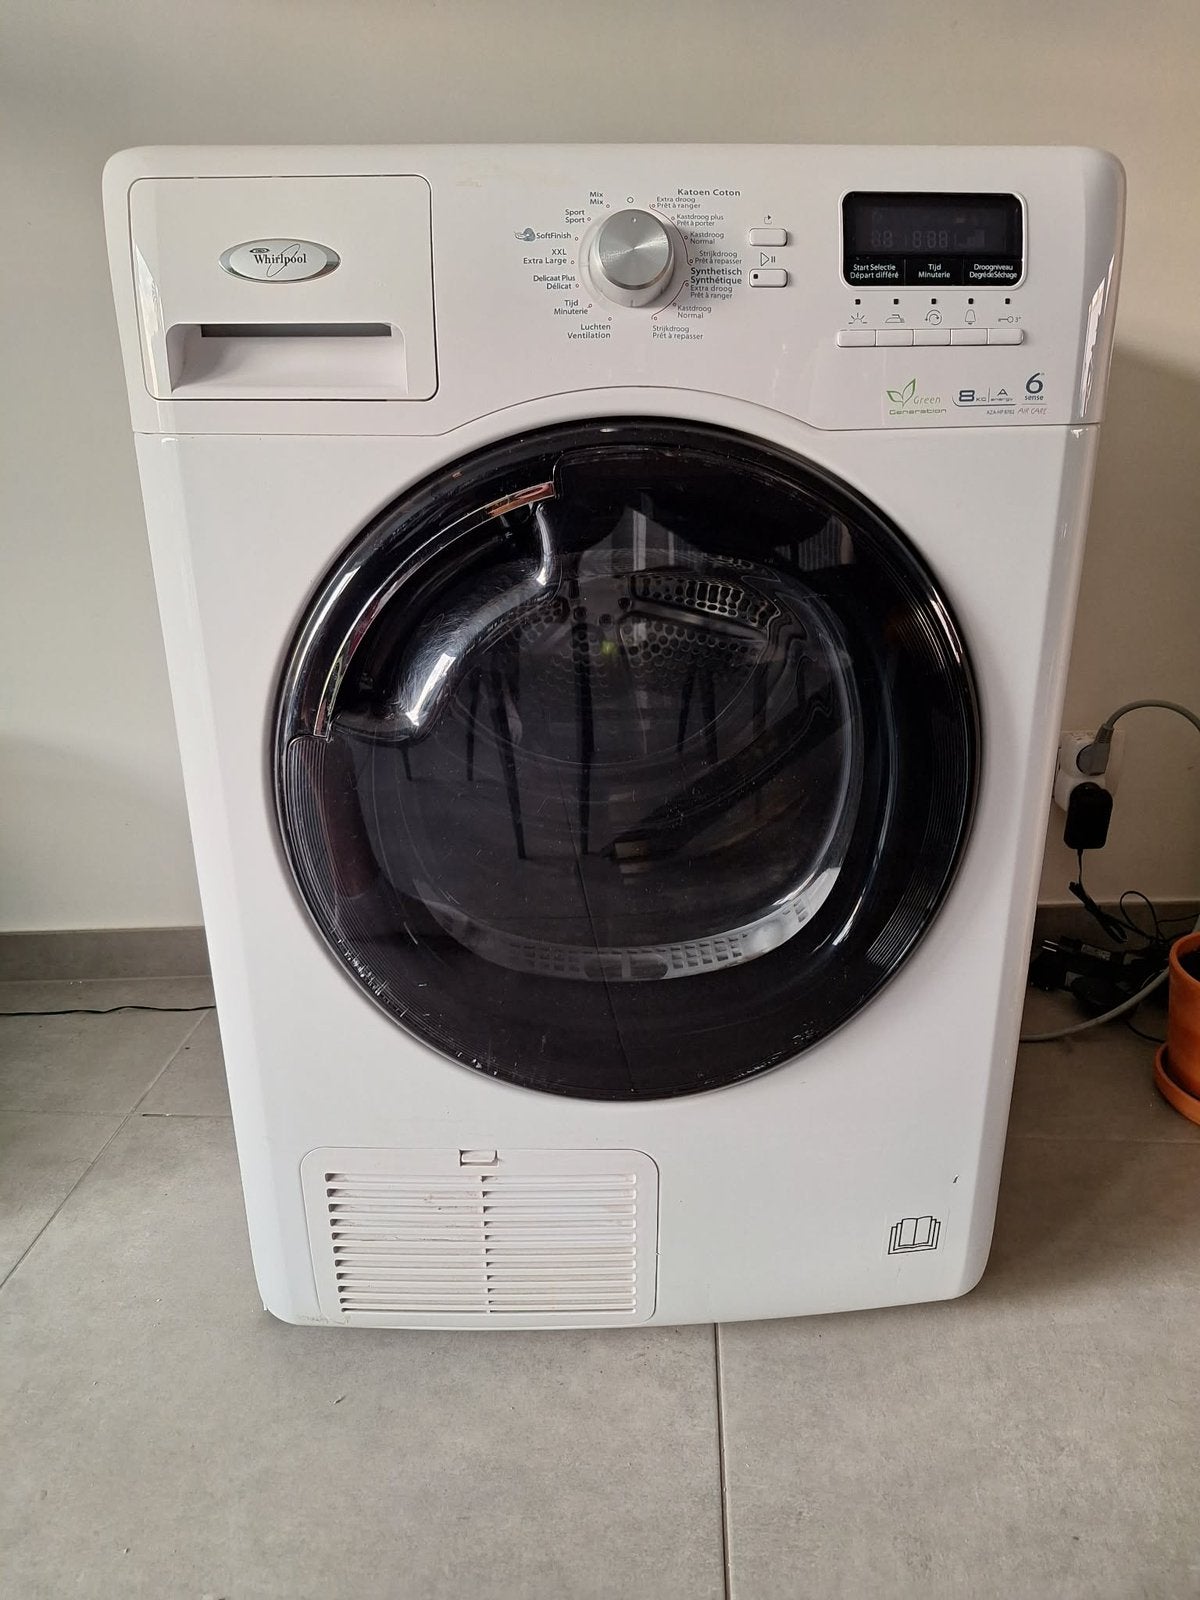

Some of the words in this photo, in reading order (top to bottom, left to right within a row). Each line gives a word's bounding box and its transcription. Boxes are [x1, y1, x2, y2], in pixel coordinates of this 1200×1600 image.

[254, 254, 307, 266] Whirlpool
[545, 257, 567, 265] Large
[690, 267, 742, 276] Synthetisch
[973, 264, 1013, 272] Droogniveau
[690, 276, 742, 285] Synthétique
[565, 299, 578, 308] Tijd
[914, 395, 941, 405] Green
